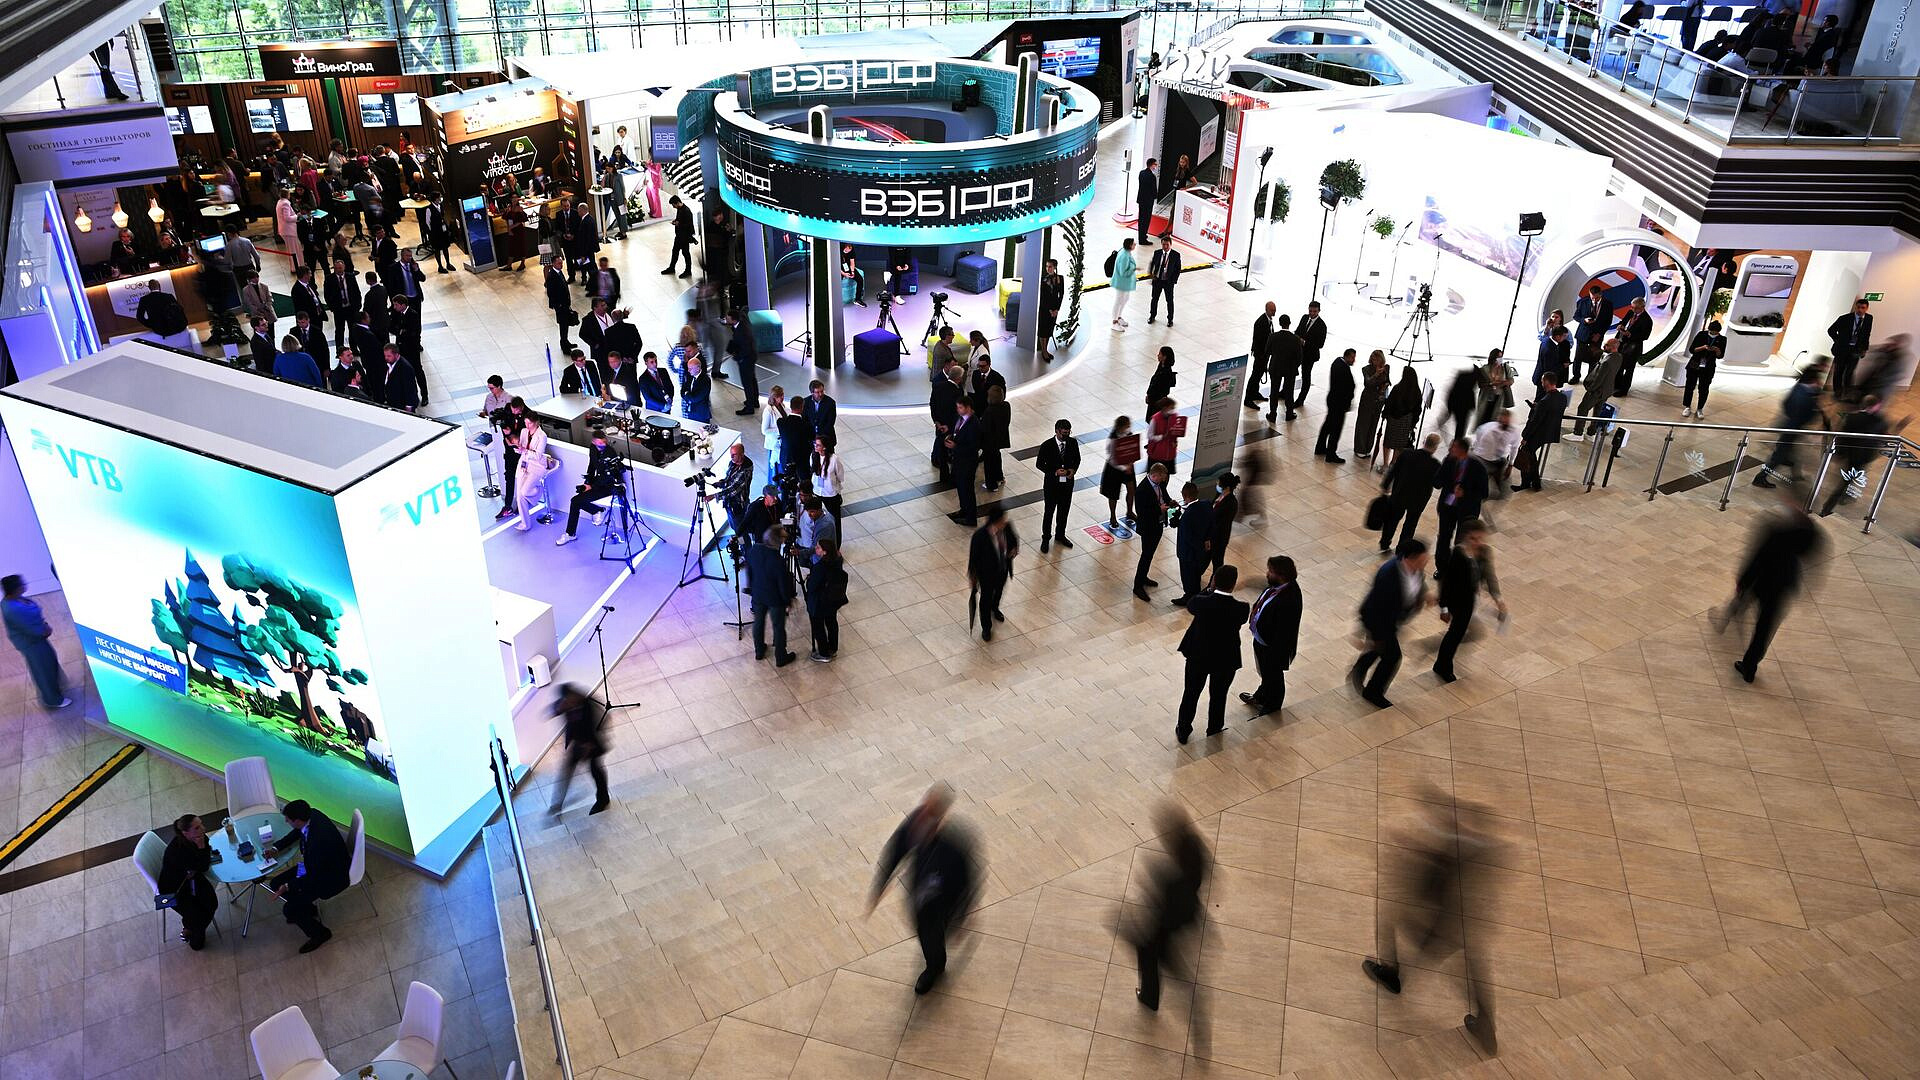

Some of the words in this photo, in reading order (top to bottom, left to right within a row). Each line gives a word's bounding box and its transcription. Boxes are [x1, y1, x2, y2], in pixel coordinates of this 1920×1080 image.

[1180, 84, 1222, 101] КОМПАНИЙ
[28, 140, 79, 151] ГОСТИНАЯ
[83, 131, 151, 145] ГУБЕРНАТОРОВ
[655, 132, 675, 141] ВЭБ
[98, 155, 121, 164] Lounge
[482, 161, 523, 179] VinoGrad
[1751, 262, 1775, 270] Прогулка
[56, 444, 123, 492] VTB
[404, 475, 462, 526] VTB
[95, 636, 110, 649] ЛЕС
[98, 648, 122, 664] НИКТО
